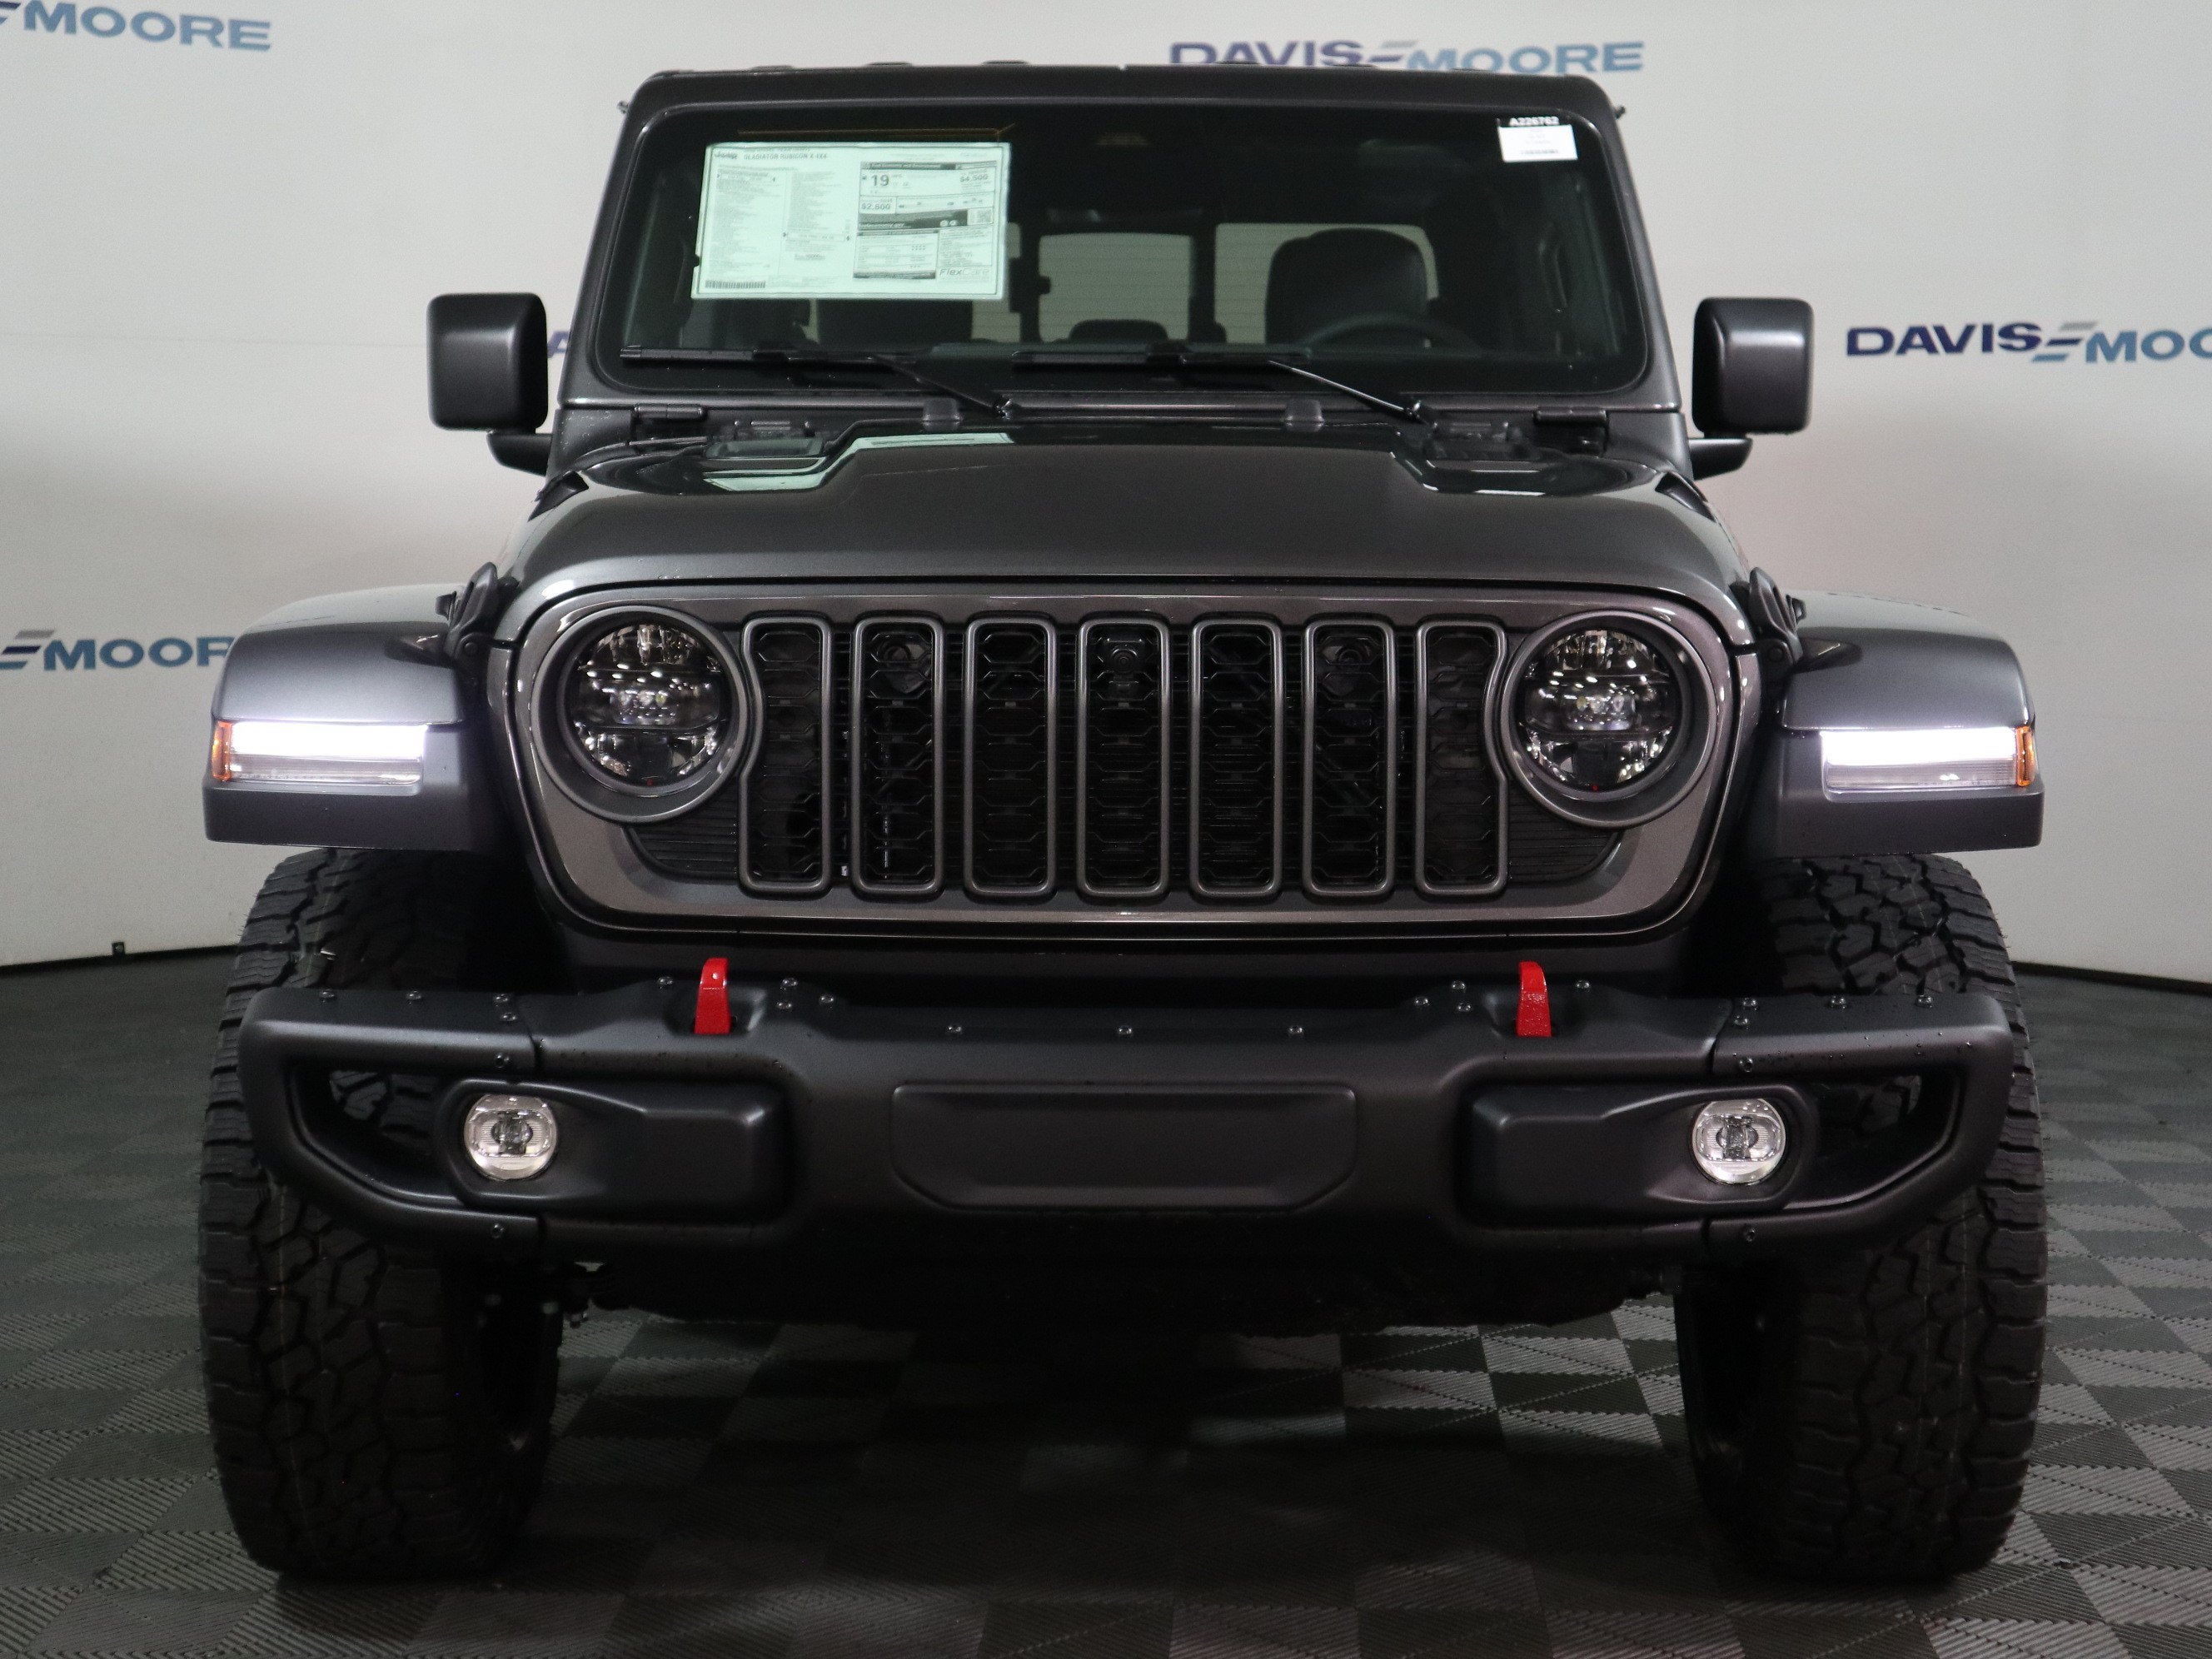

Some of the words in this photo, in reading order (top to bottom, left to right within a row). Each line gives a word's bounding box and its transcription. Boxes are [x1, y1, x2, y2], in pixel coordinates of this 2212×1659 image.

[23, 0, 271, 51] MOORE
[1169, 40, 1363, 67] DAVIS
[1406, 42, 1645, 74] MOORE
[871, 174, 889, 187] 19
[1846, 322, 2043, 356] DAVIS
